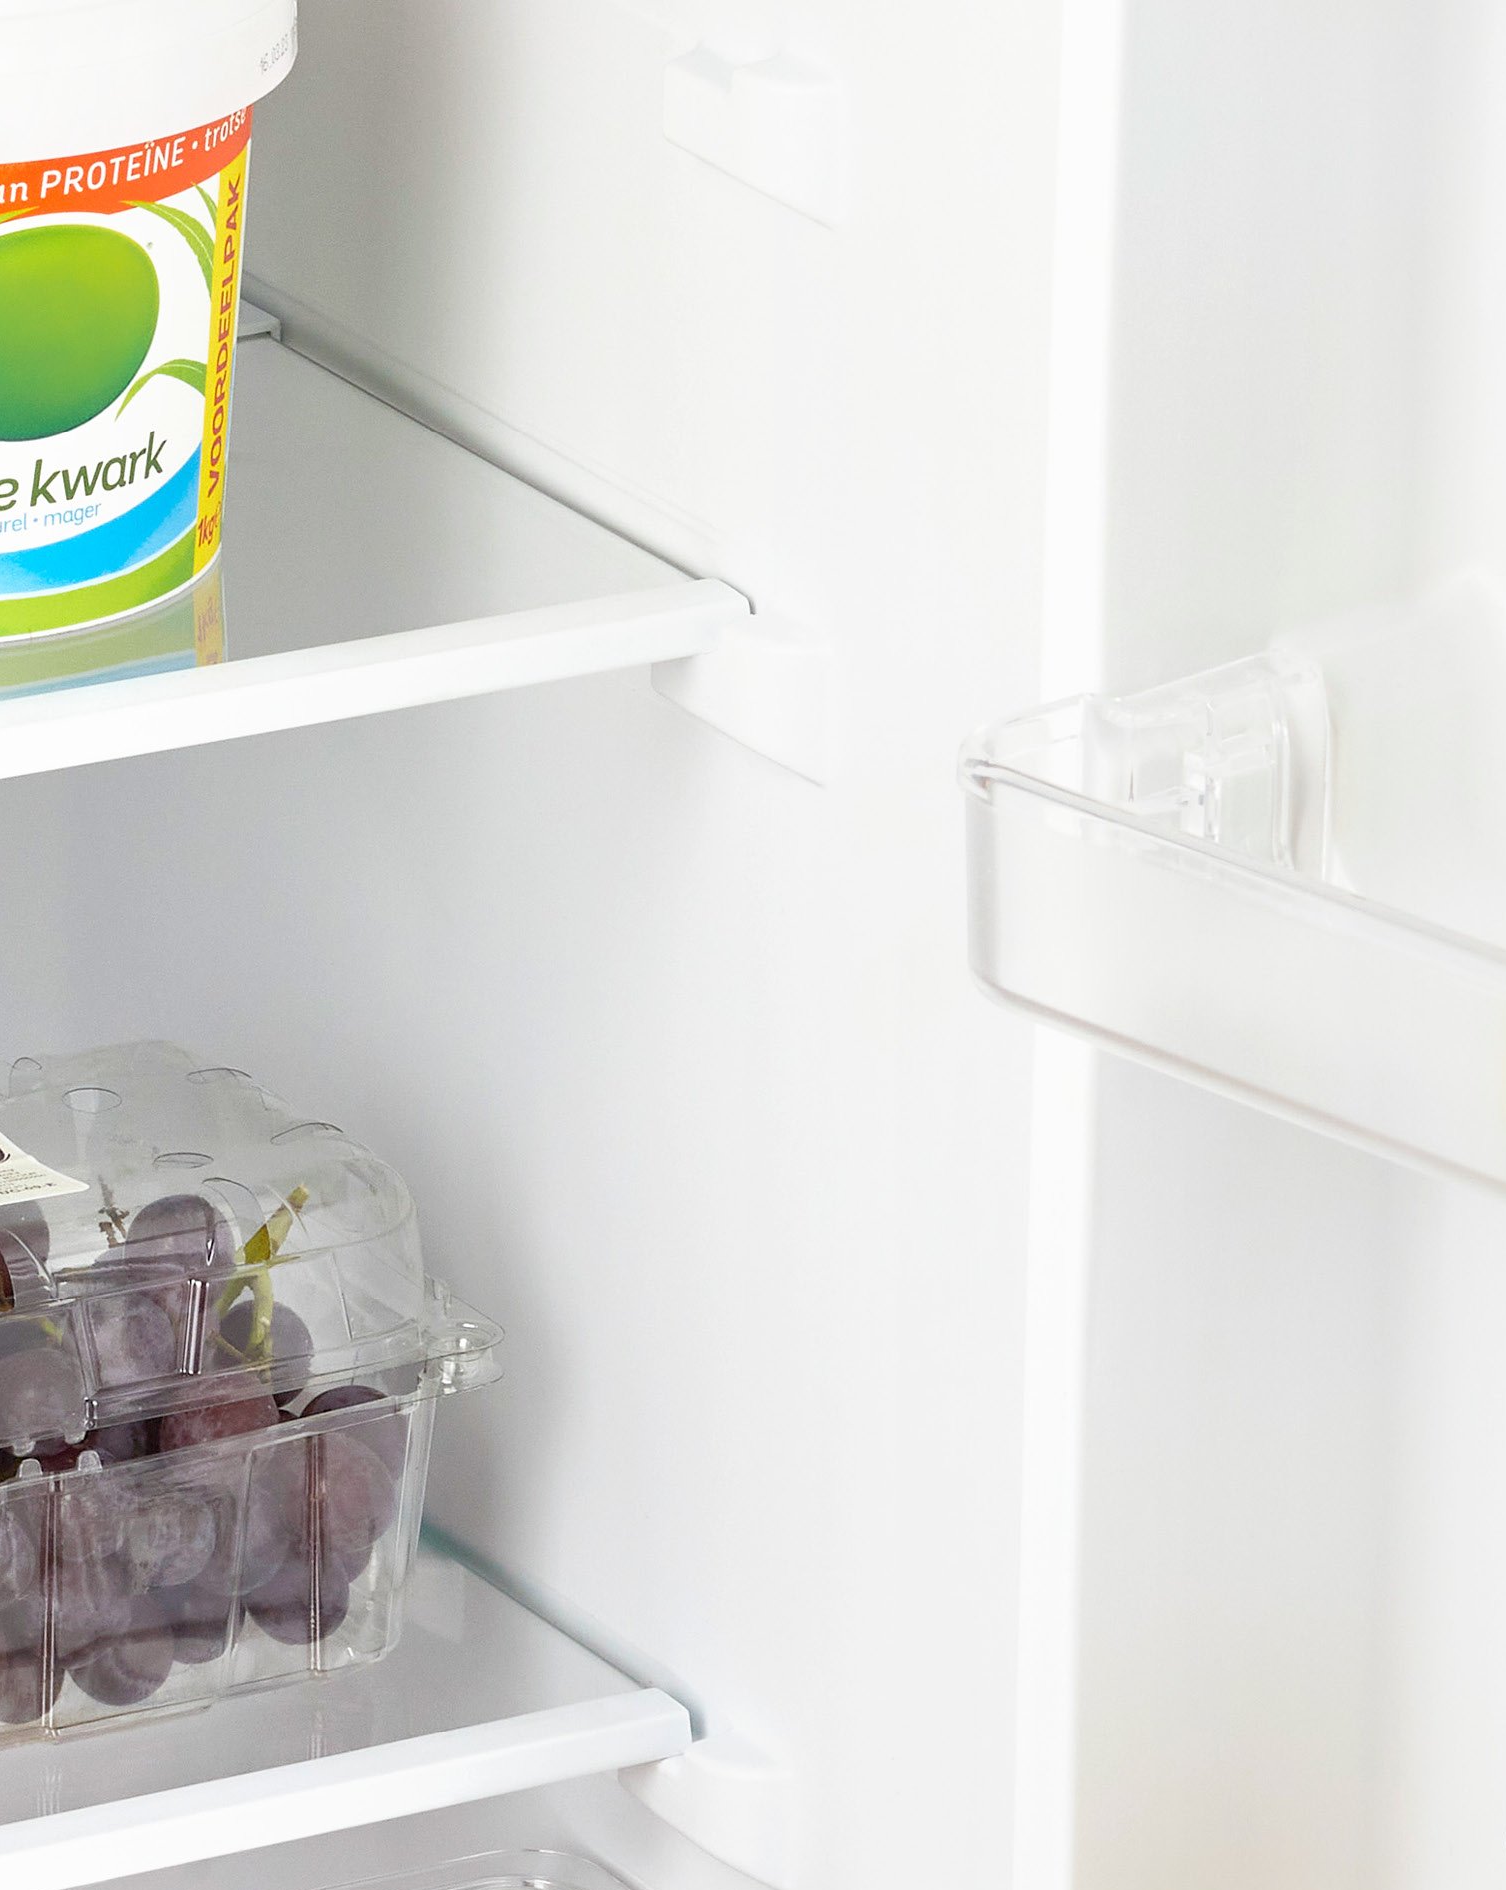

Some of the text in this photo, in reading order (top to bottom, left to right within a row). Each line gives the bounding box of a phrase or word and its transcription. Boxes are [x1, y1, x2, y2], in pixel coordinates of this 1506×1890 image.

[40, 136, 187, 200] PROTEÏNE
[207, 172, 242, 499] VOORDEELPAK
[29, 430, 168, 508] kwark
[43, 501, 102, 528] mager
